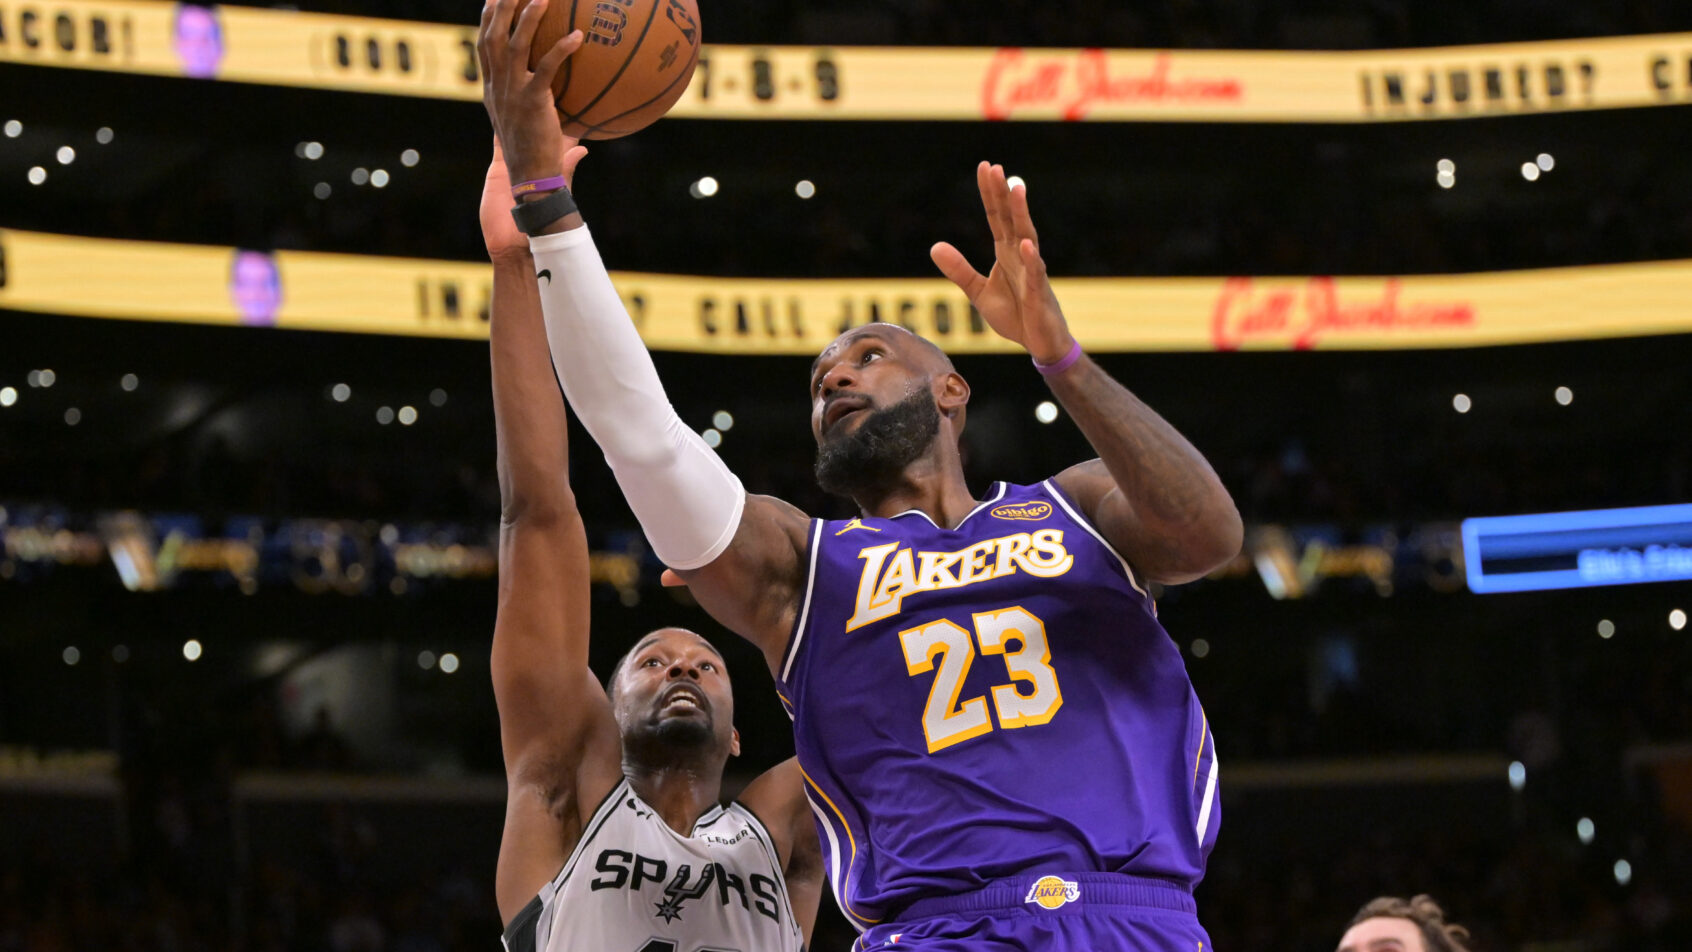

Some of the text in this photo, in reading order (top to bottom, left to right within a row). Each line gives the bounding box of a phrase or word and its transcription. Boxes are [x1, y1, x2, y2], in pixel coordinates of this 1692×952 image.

[700, 298, 807, 337] CALL
[996, 505, 1048, 517] bibigo
[846, 529, 1073, 633] LAKERS
[898, 605, 1063, 754] 23
[707, 829, 749, 846] LEDGER
[591, 849, 780, 925] SPURS
[1026, 884, 1079, 901] LAKERS
